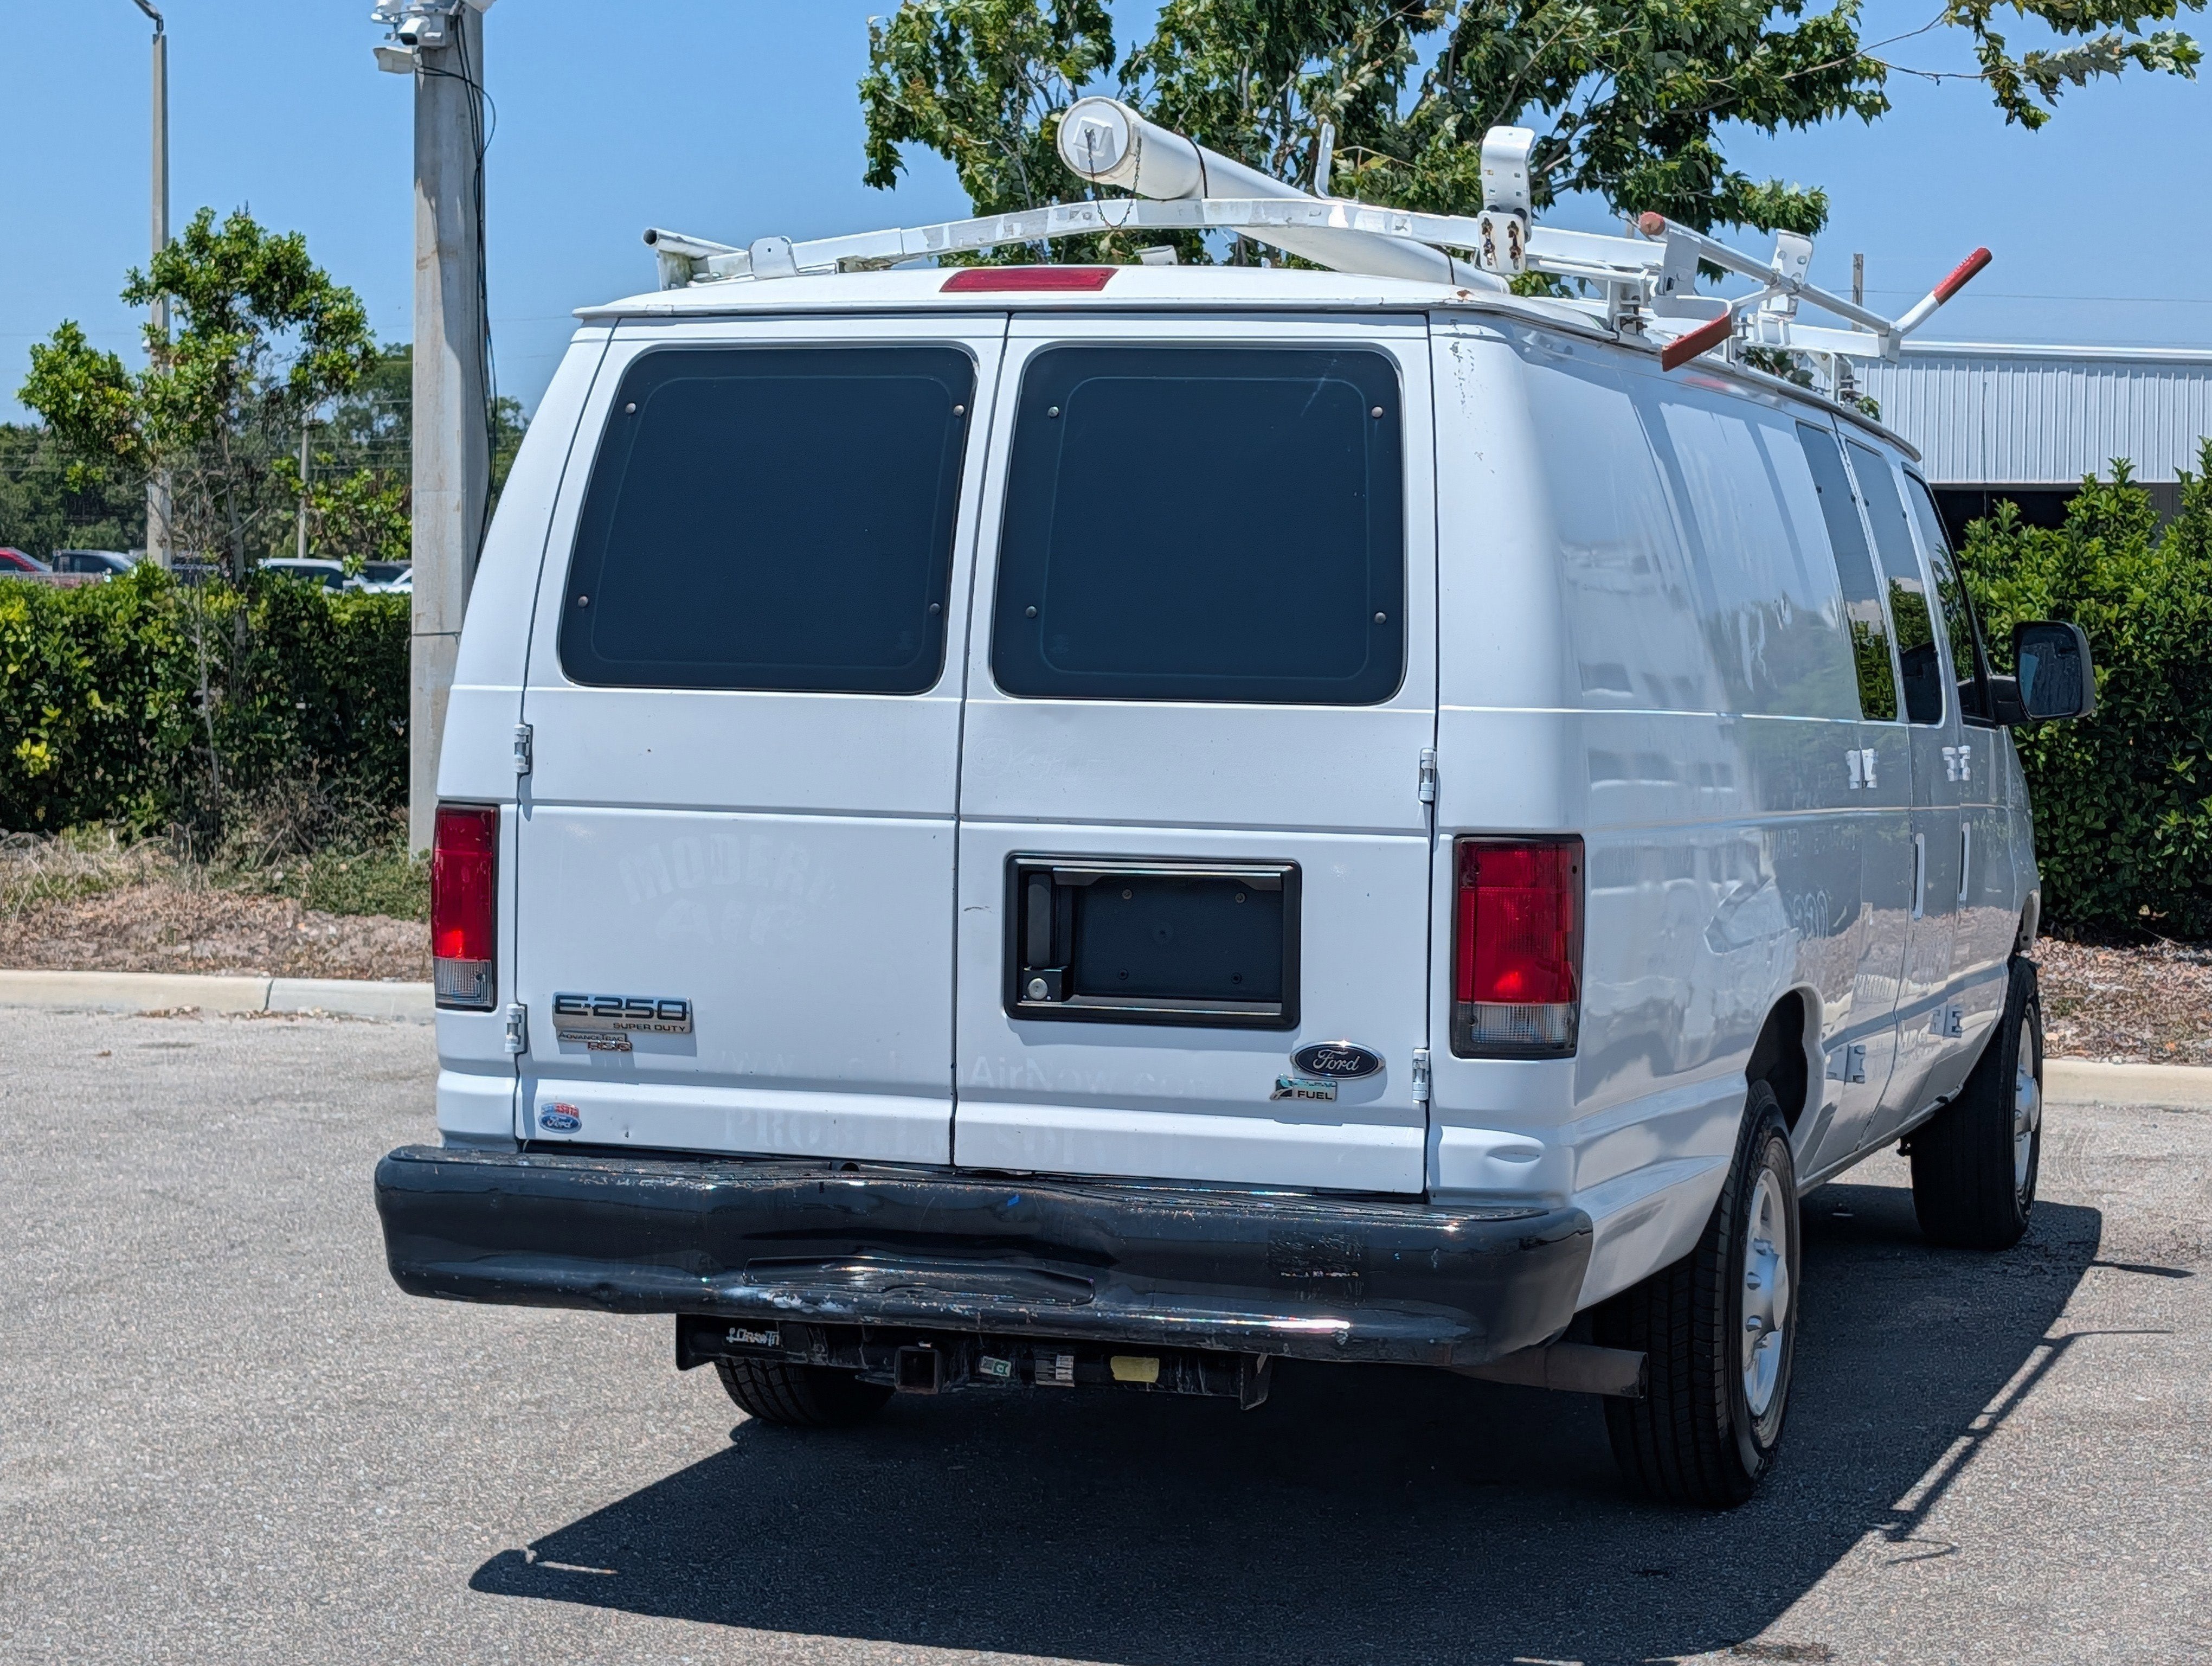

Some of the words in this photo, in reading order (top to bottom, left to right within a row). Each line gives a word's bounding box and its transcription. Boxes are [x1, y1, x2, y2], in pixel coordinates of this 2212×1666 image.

[555, 995, 687, 1021] E-250
[613, 1022, 651, 1031] SUPER
[654, 1023, 686, 1031] DUTY
[1312, 1048, 1361, 1071] Ford
[1297, 1090, 1333, 1100] FUEL
[546, 1116, 573, 1129] Ford
